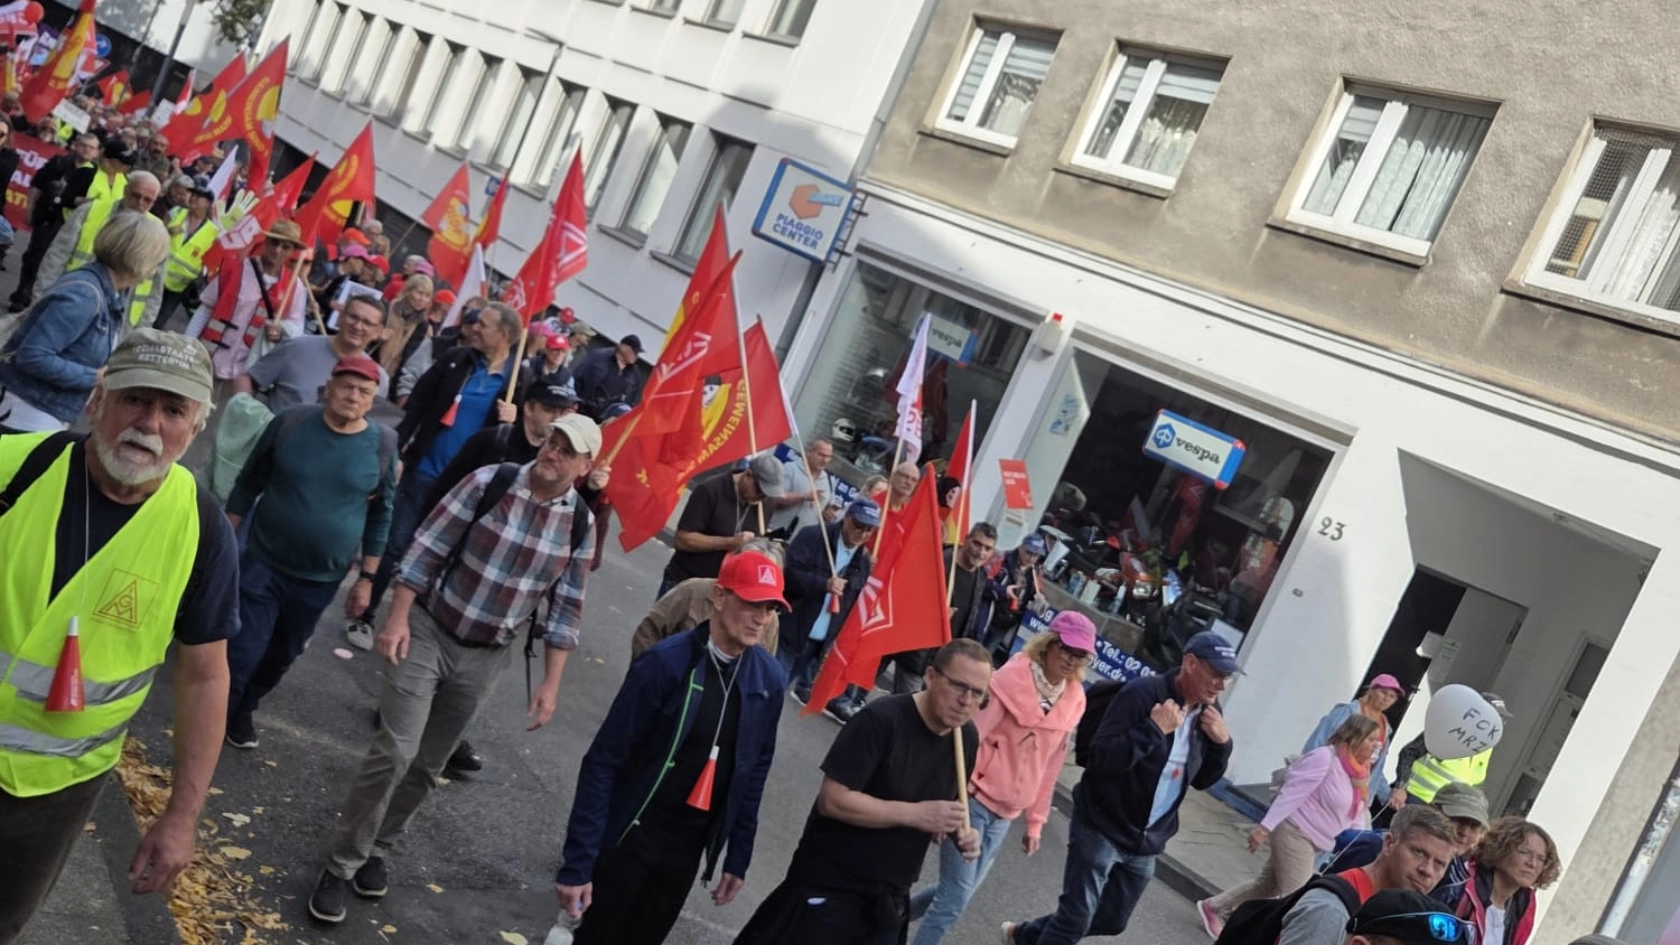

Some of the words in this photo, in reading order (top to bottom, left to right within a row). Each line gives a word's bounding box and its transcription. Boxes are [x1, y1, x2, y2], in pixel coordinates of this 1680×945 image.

[772, 223, 818, 250] CENTER
[776, 213, 823, 240] PIAGGIO
[1175, 437, 1220, 464] vespa
[1317, 516, 1346, 541] 23
[1463, 707, 1500, 740] FCK
[1448, 727, 1488, 752] MRZ
